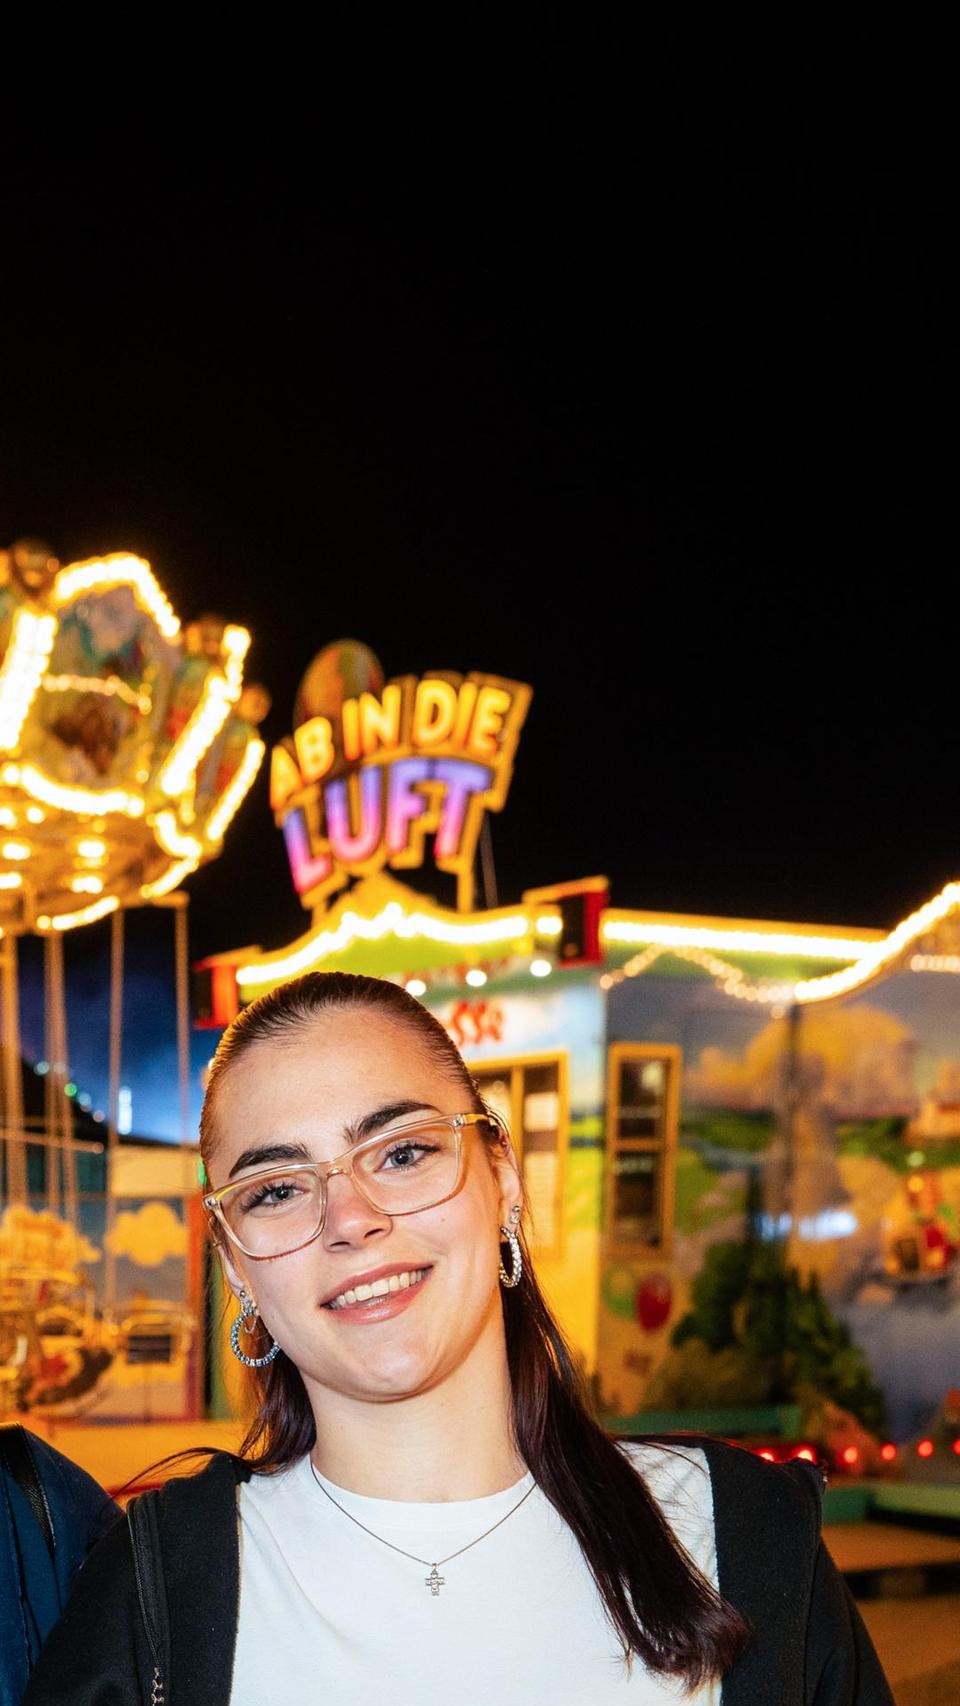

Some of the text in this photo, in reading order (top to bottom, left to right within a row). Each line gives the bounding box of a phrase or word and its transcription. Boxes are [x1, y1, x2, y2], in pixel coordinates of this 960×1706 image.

[270, 678, 512, 810] AB IN DIE
[283, 755, 492, 894] LUFT
